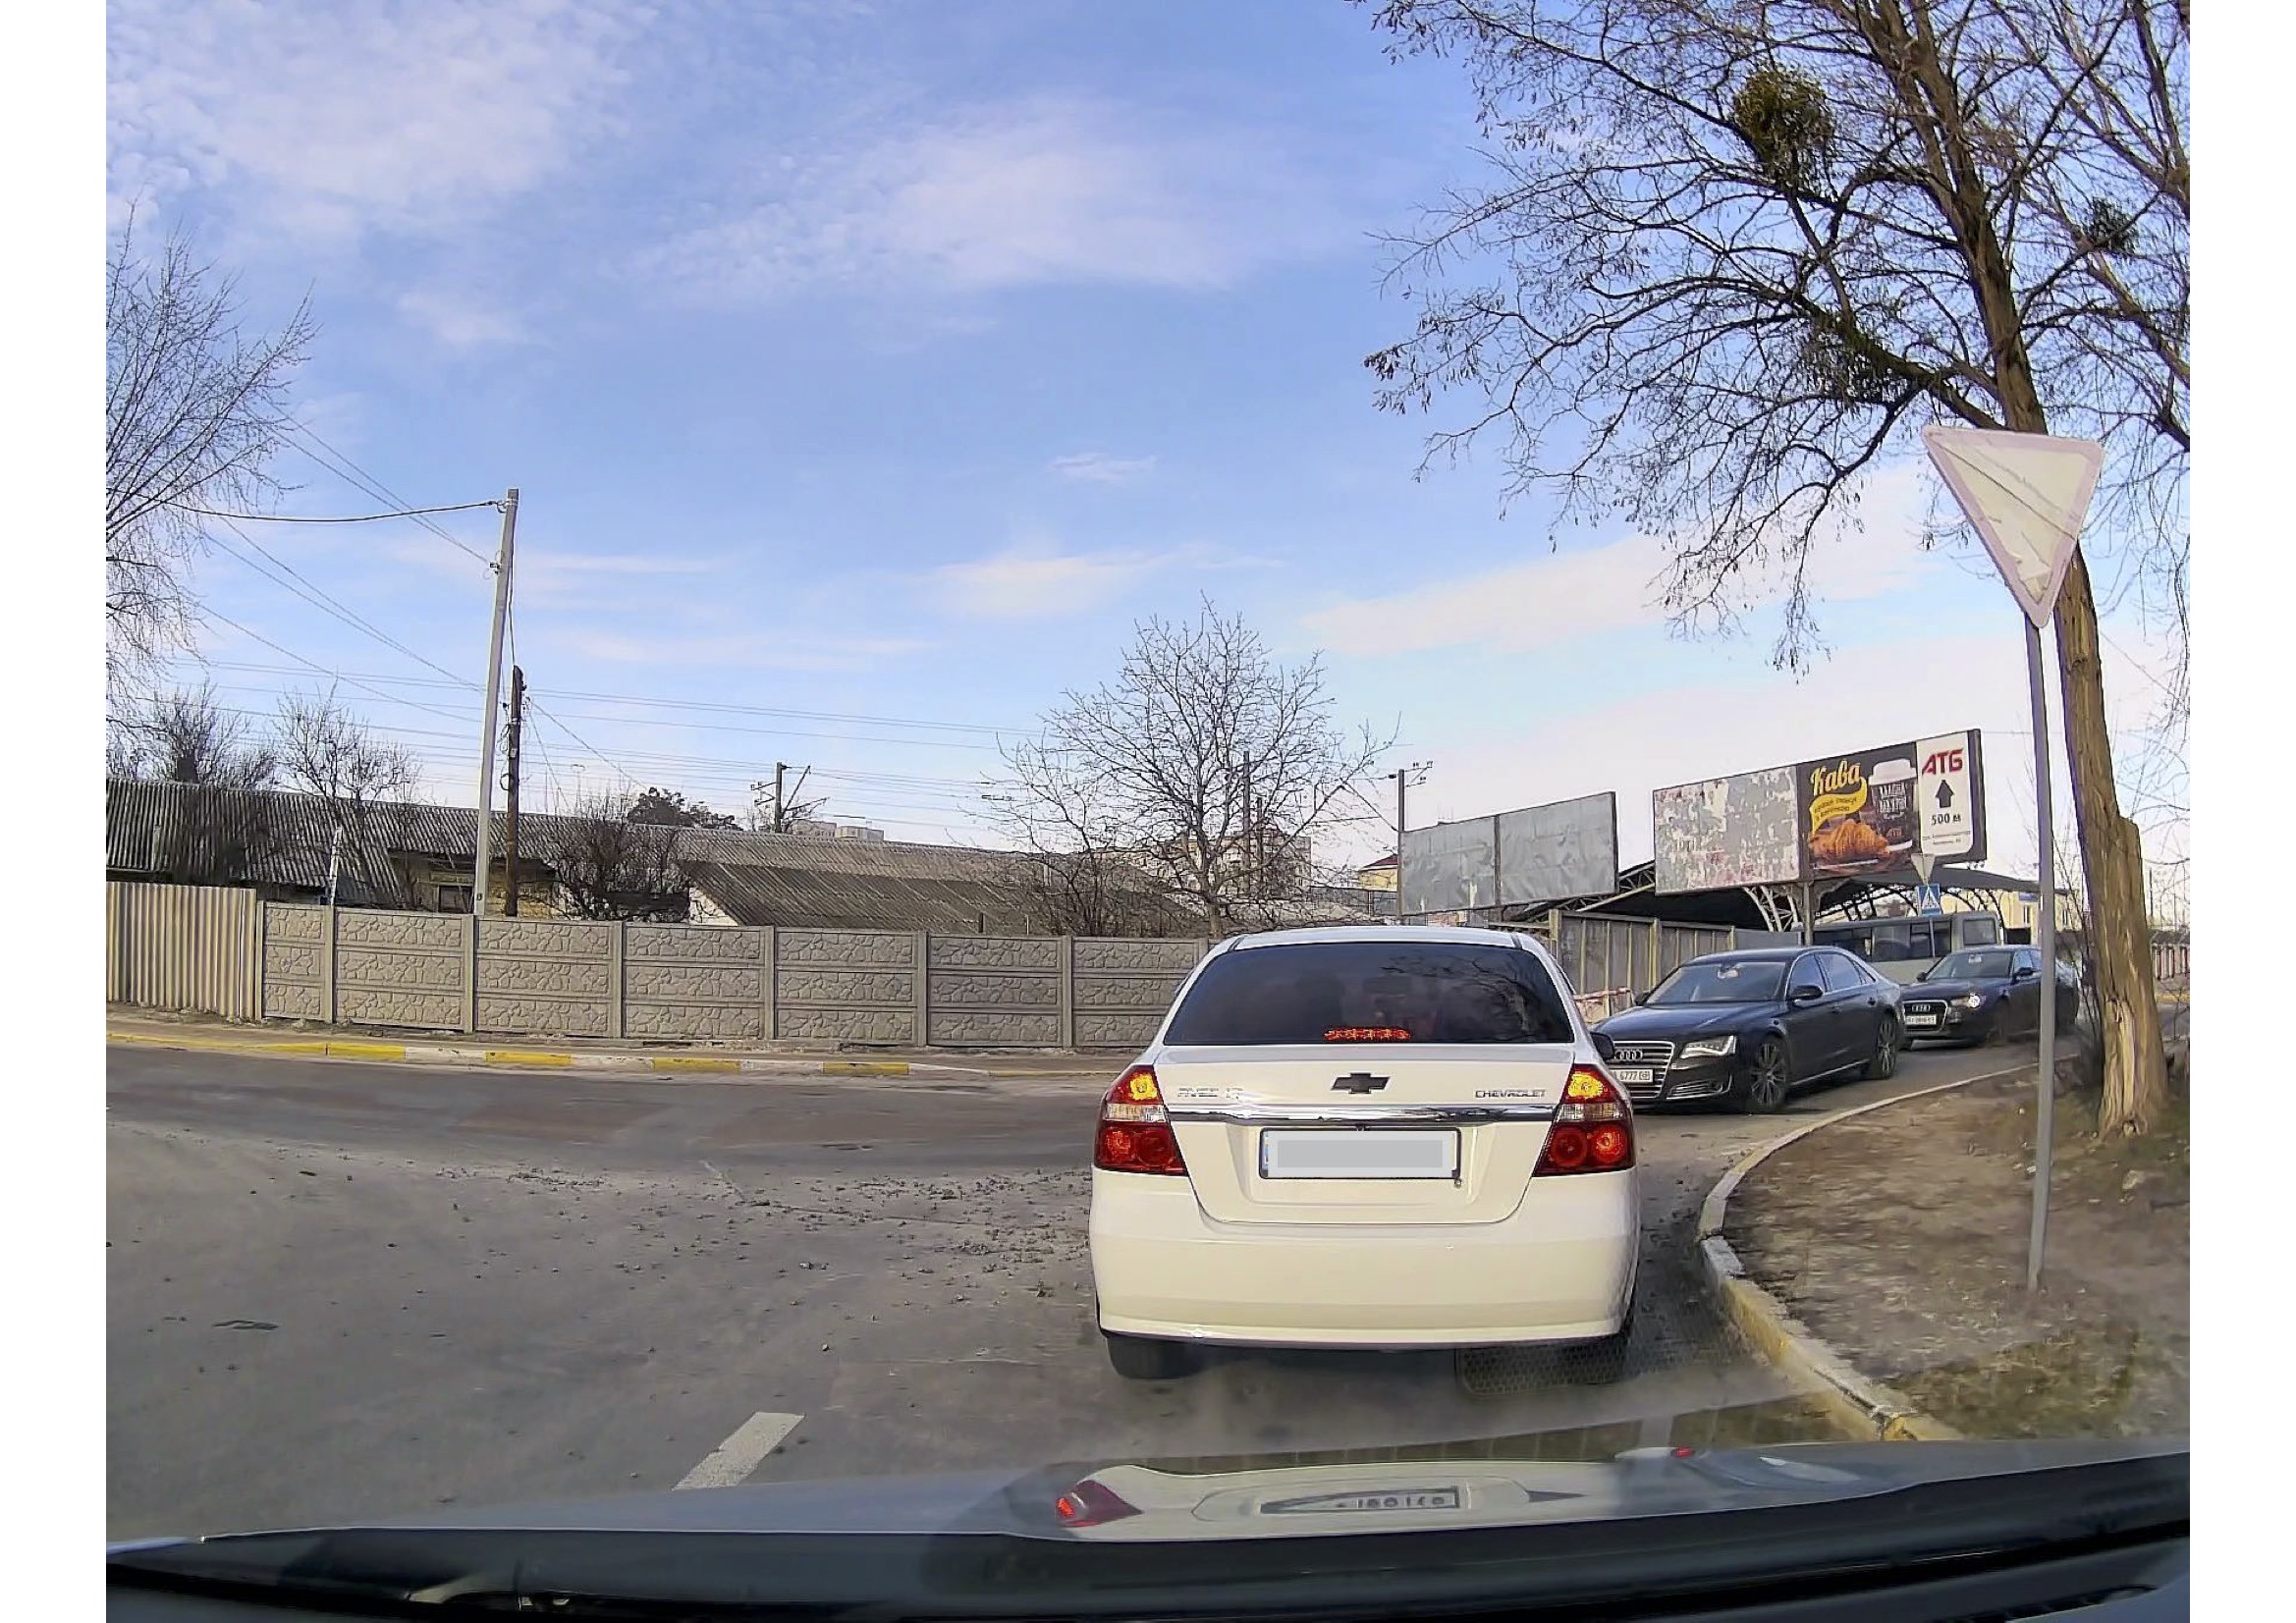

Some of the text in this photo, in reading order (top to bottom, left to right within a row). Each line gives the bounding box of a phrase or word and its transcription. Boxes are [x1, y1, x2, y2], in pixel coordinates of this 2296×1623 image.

[1922, 748, 1964, 777] АТБ
[1931, 812, 1950, 826] 500
[1475, 1089, 1546, 1098] CHEVROLET
